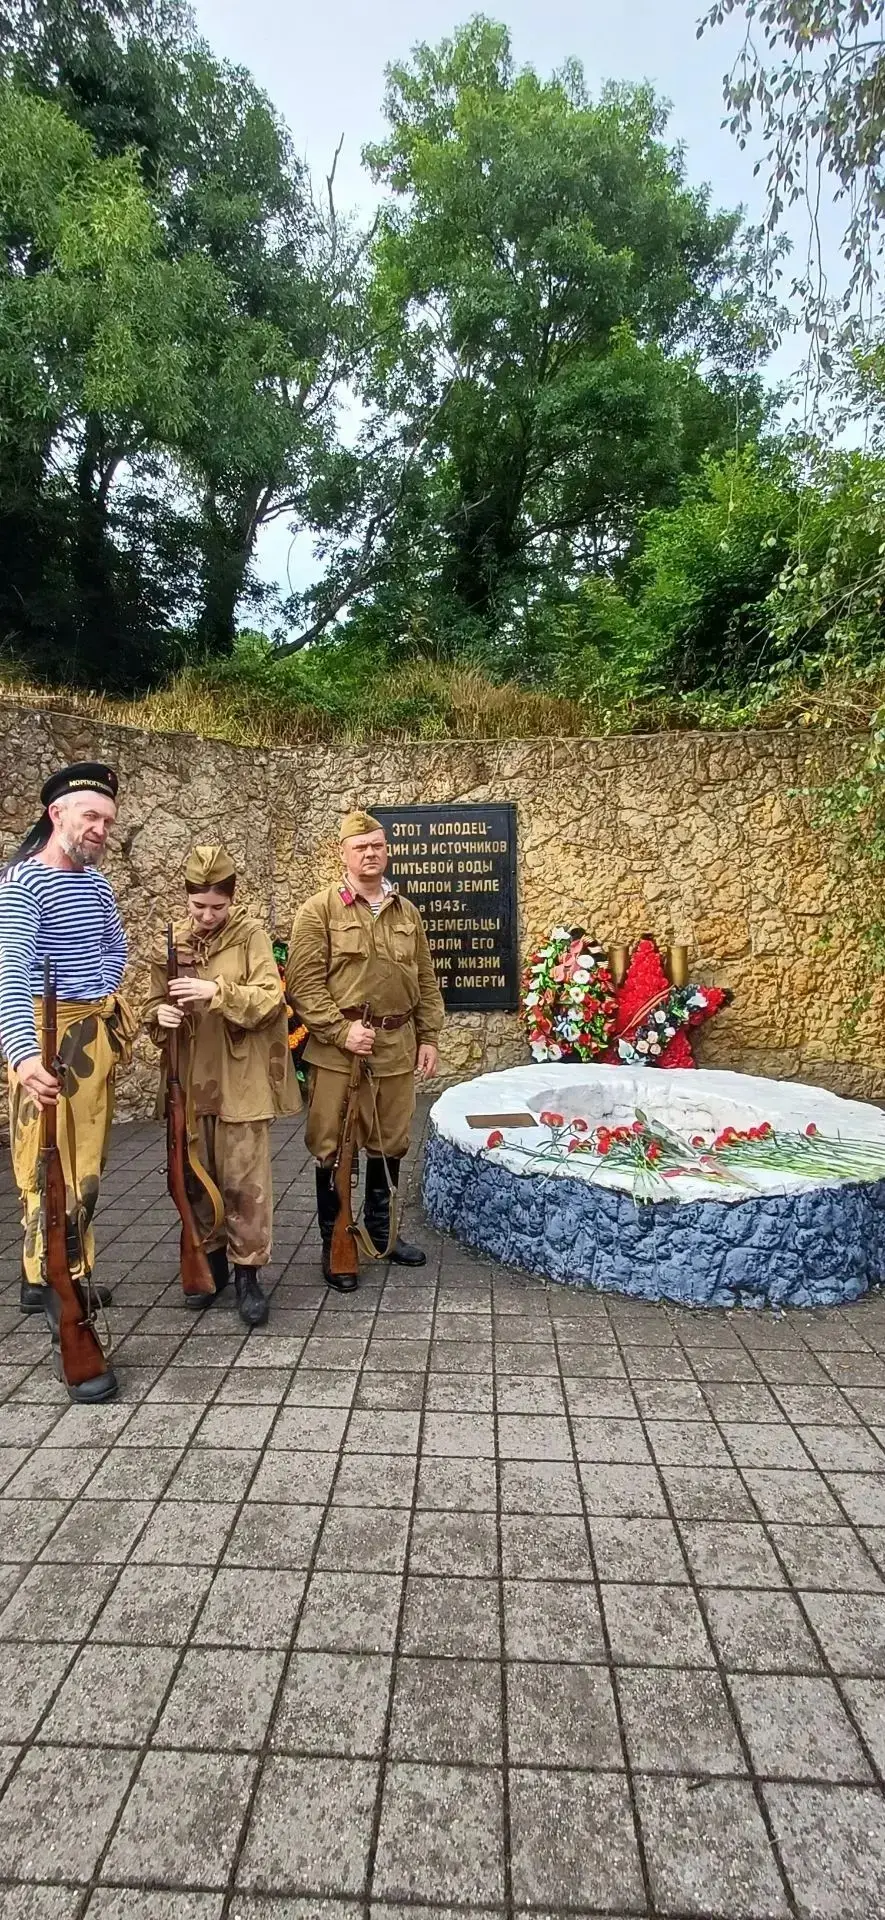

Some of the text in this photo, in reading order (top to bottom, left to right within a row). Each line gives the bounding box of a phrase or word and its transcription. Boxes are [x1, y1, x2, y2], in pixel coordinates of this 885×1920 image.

[392, 822, 422, 837] ЭТОТ
[386, 840, 507, 857] ДИН ИЗ ИСТОЧНИКОВ
[392, 859, 493, 875] ПИТЬЕВОЙ ВОДЫ
[455, 879, 500, 893] ЗЕМЛЕ
[421, 917, 500, 932] ОЗЕМЕЛЬЦЫ
[429, 937, 495, 951] ВАЛИ ЕГО
[457, 956, 501, 969] ЖИЗНИ
[454, 974, 506, 988] СМЕРТИ
